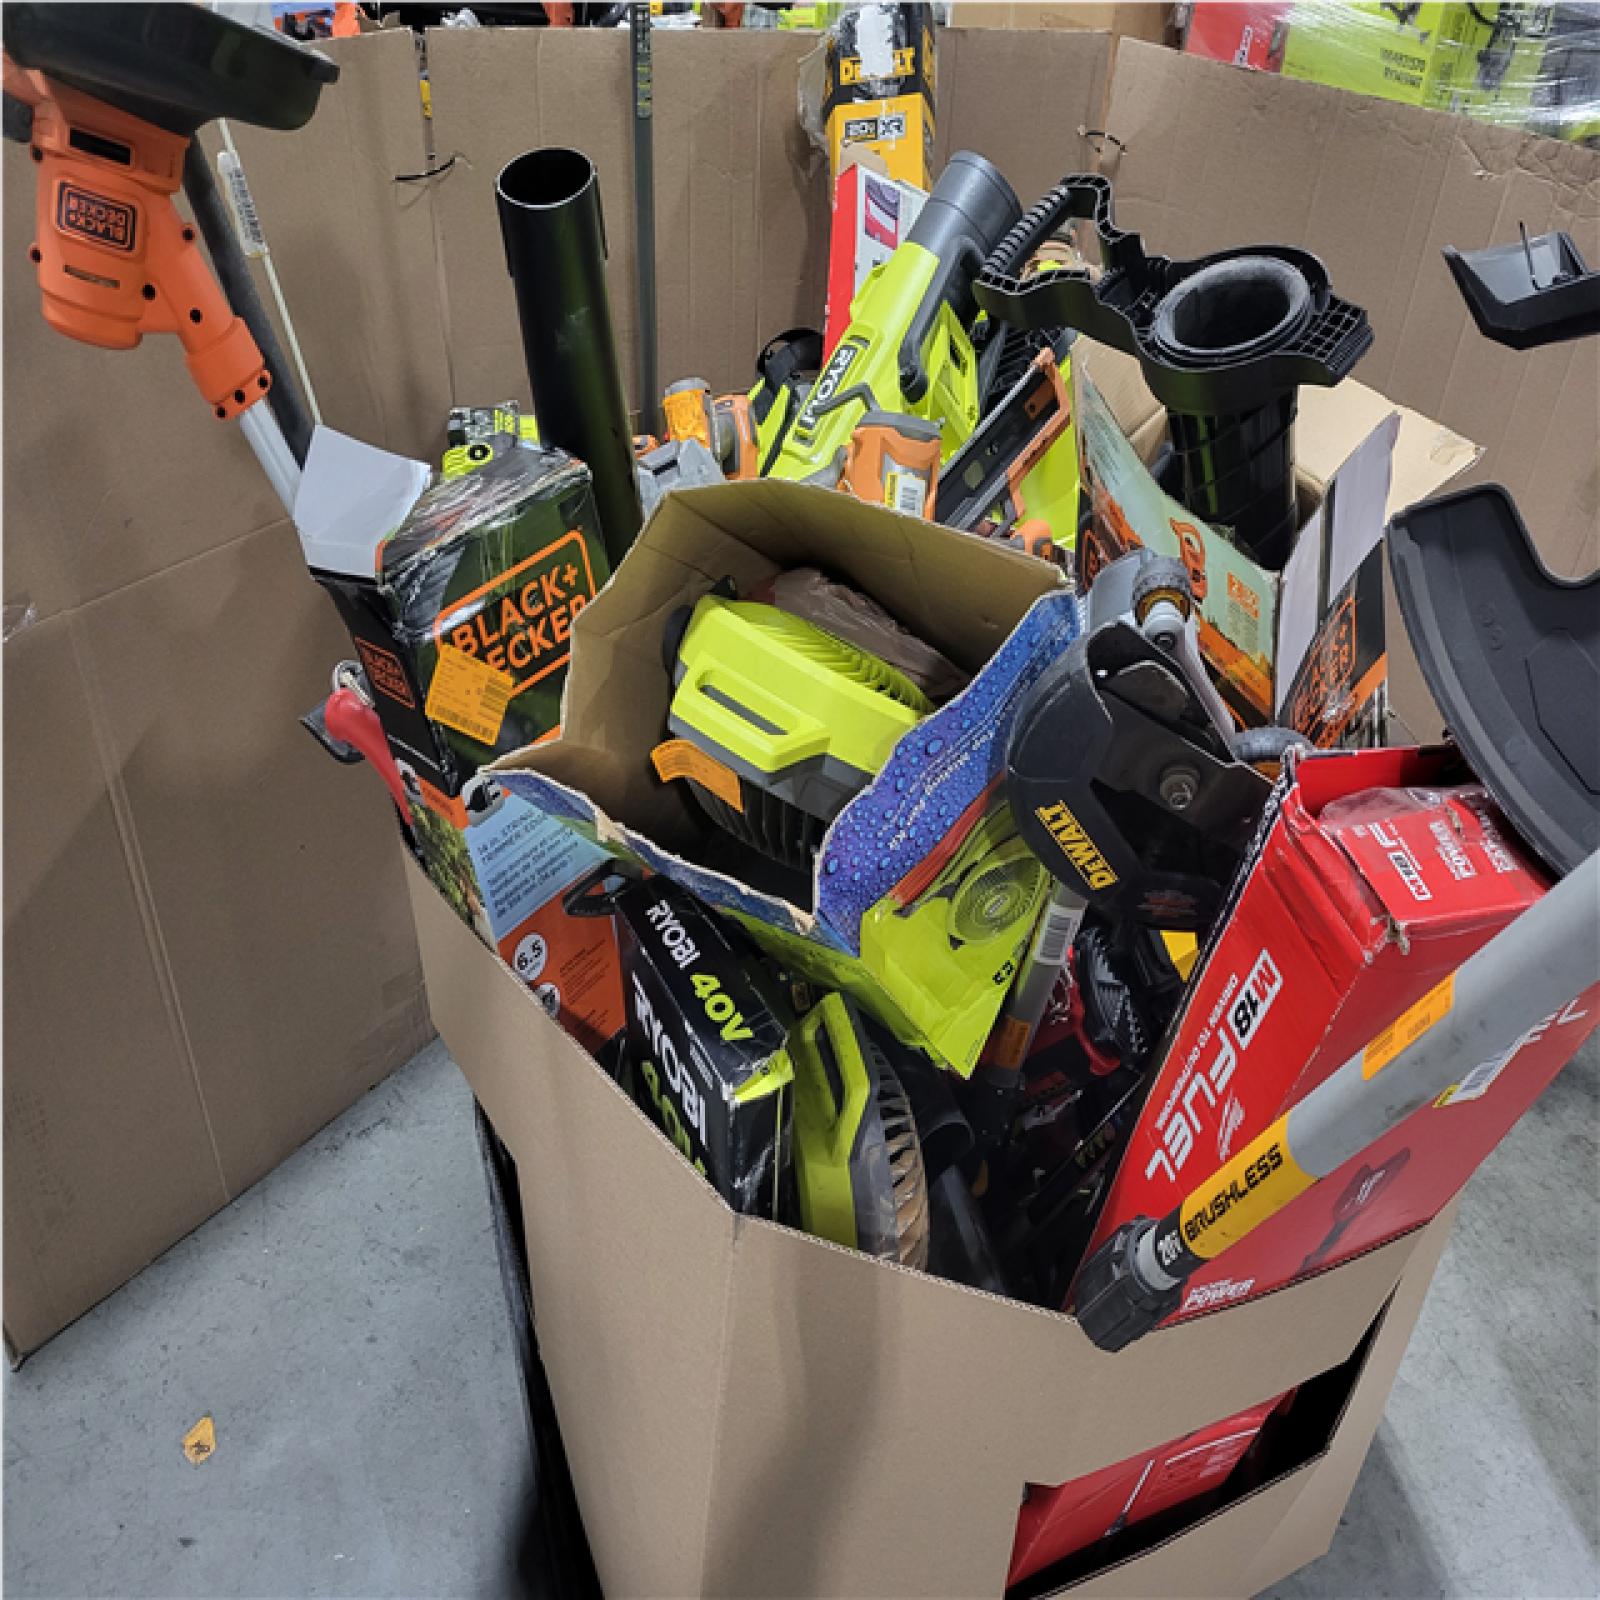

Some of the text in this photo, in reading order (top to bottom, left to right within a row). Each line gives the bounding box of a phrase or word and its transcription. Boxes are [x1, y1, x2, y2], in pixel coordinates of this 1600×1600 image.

[451, 563, 578, 655] BLACK+
[1036, 801, 1118, 890] DEWALT
[517, 940, 542, 972] 6.5
[646, 901, 700, 970] RYOBI
[690, 973, 753, 1040] 40V
[1230, 953, 1281, 1044] M18
[1145, 1027, 1238, 1182] FUEL
[1184, 1141, 1283, 1243] BRUSHLESS
